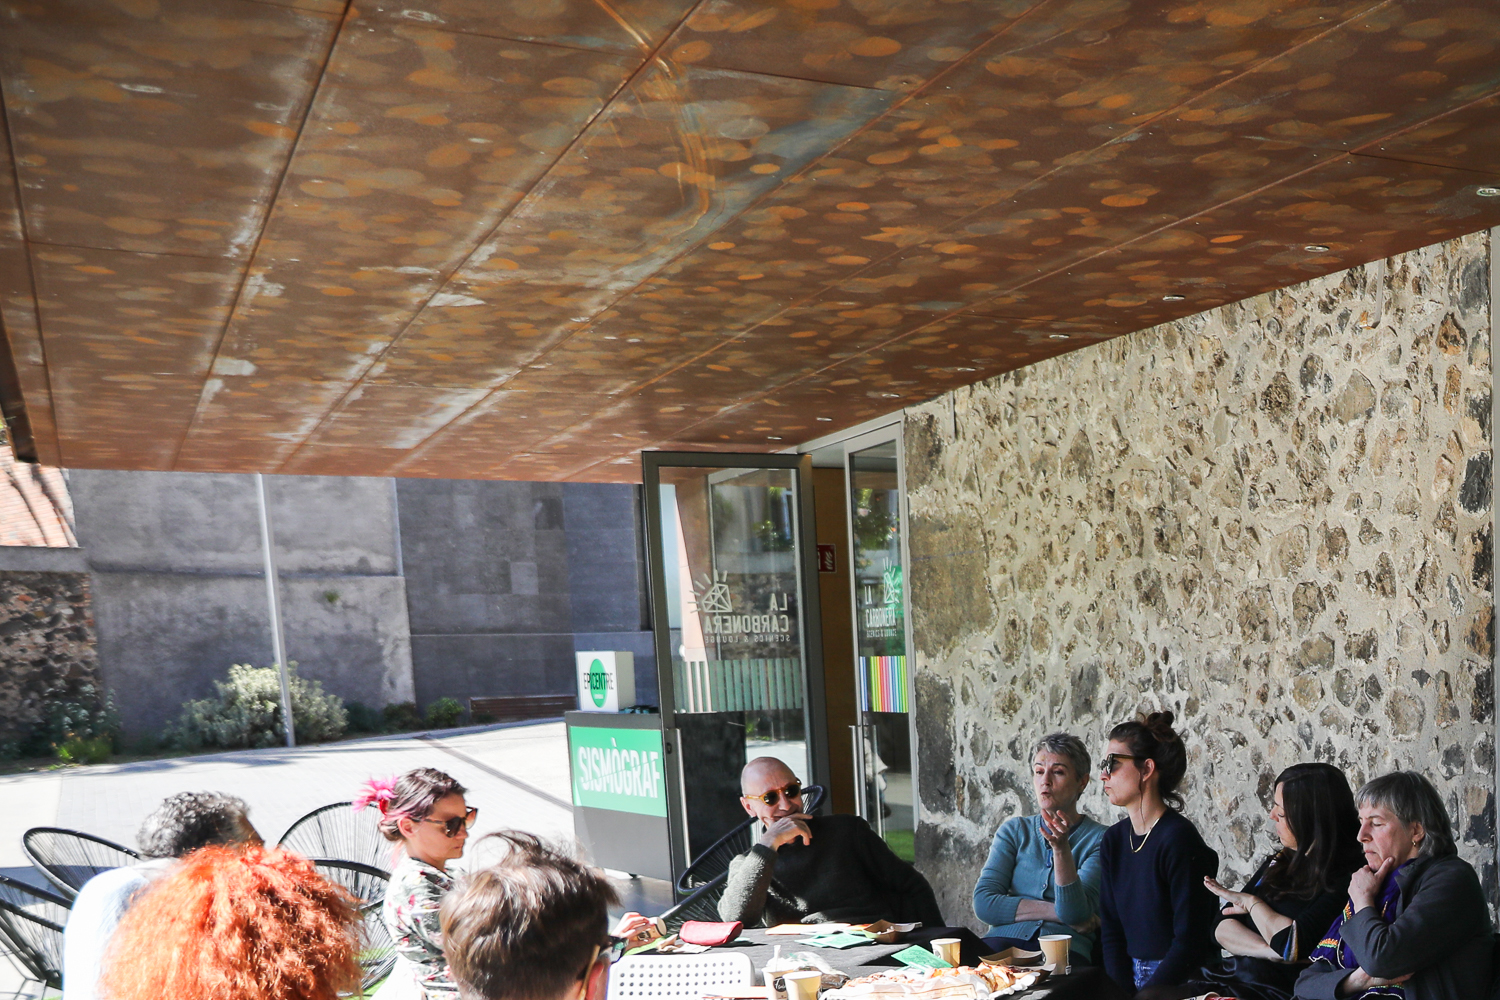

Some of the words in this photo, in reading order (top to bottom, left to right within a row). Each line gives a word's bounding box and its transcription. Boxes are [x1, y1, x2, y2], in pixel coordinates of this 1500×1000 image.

[864, 585, 872, 605] LA
[583, 672, 614, 690] EPICENTRE
[578, 737, 660, 798] SISMÒGRAF
